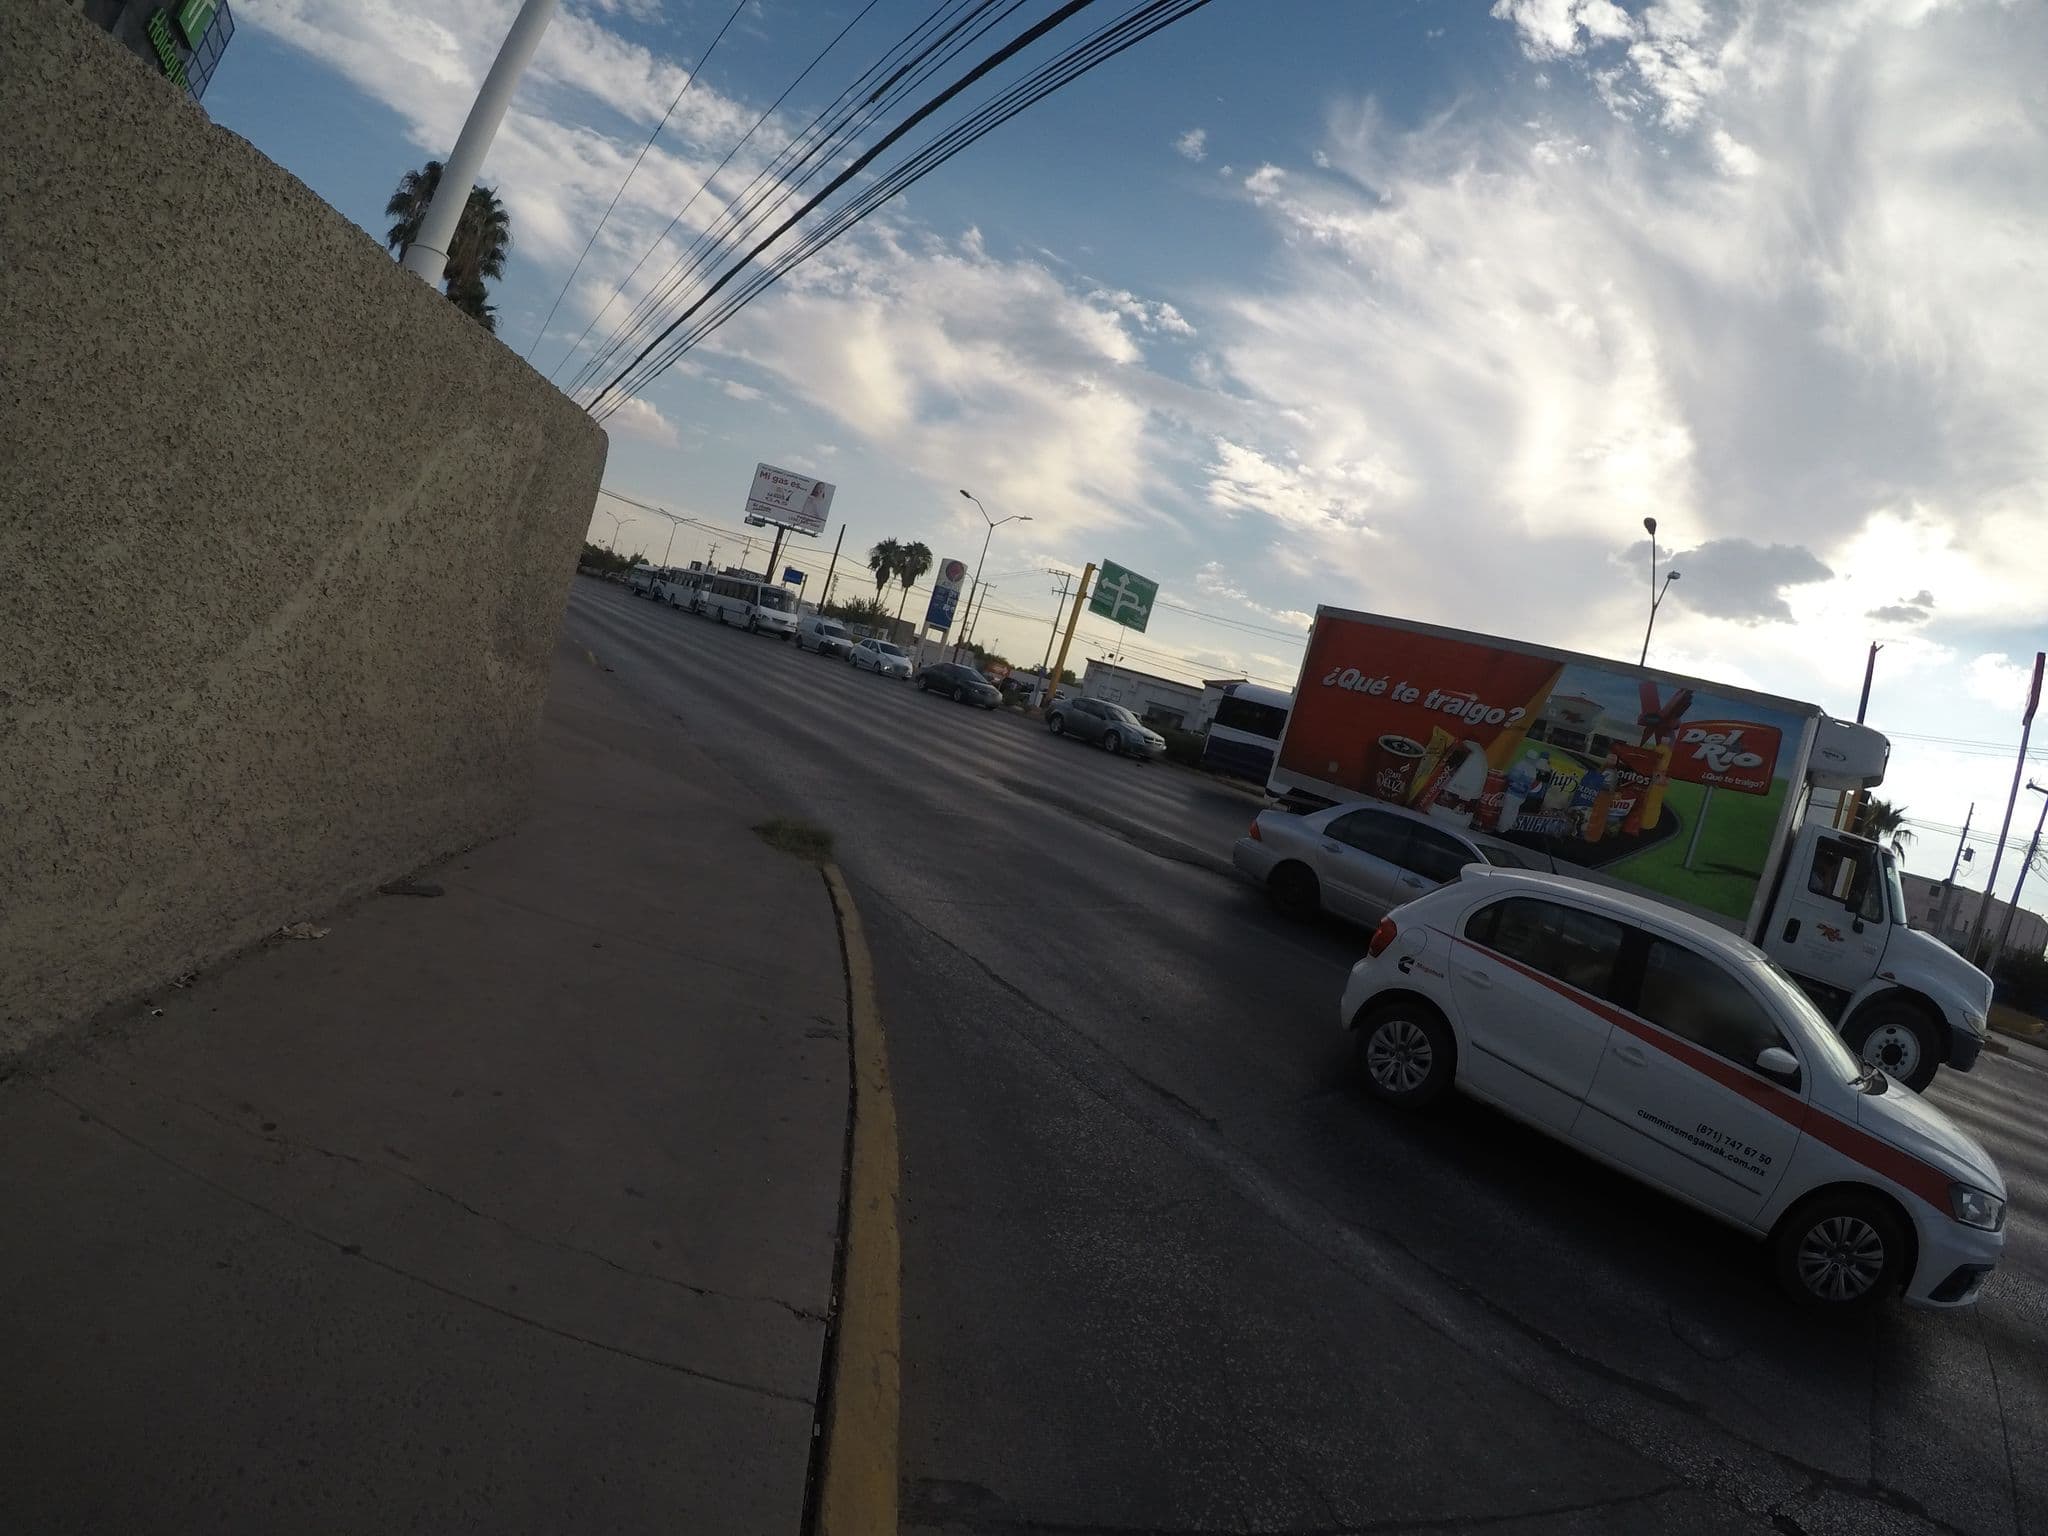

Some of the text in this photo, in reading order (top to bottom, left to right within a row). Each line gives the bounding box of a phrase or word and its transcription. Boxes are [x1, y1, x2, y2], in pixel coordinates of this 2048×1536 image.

[1322, 667, 1526, 727] ¿Qué te traigo?
[1681, 729, 1745, 746] Del
[1616, 769, 1650, 786] oritos
[1637, 1109, 1766, 1177] cumminsmegamak.com.mx
[1696, 1123, 1772, 1166] (871) 747 67 50
